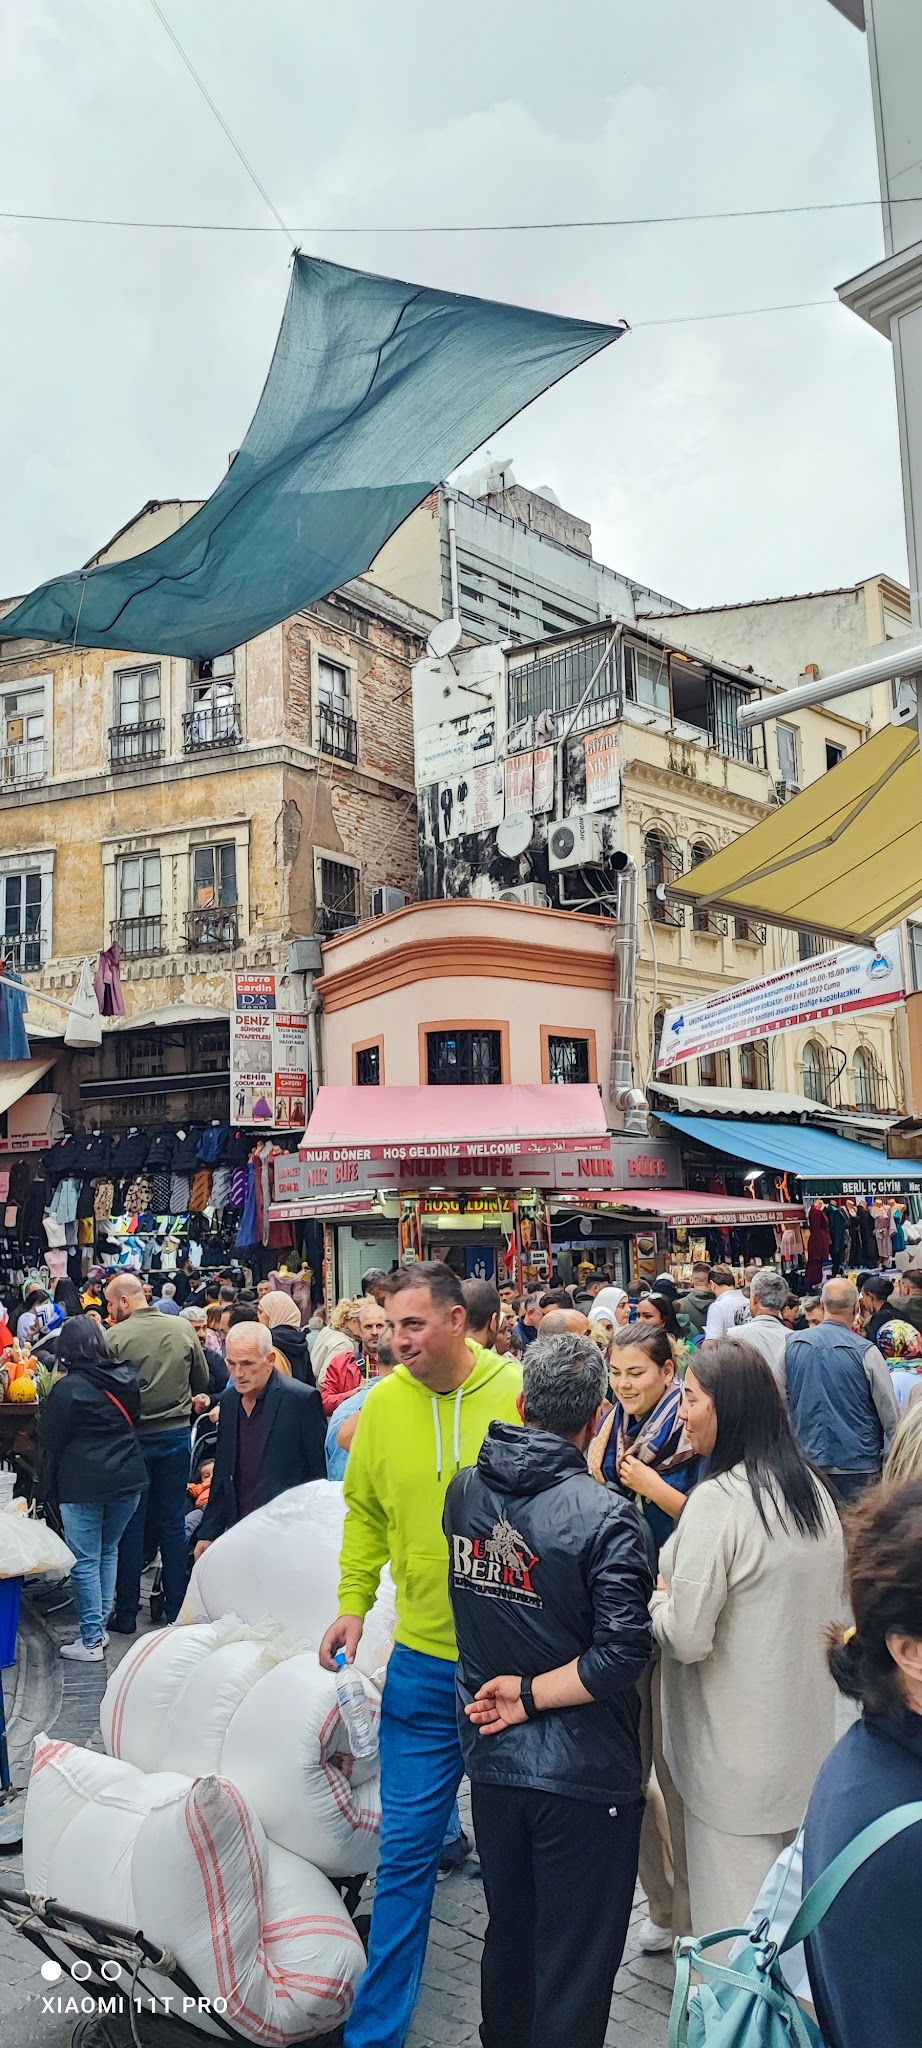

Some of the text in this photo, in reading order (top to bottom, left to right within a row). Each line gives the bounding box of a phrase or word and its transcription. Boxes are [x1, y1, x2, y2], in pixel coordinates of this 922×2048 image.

[237, 975, 271, 984] pierre
[237, 984, 272, 992] cardin
[236, 1014, 270, 1026] DENİZ
[239, 1072, 267, 1080] NEHİR
[306, 1142, 521, 1162] NUR DÖNER HOŞ GELDİNİZ WELCOME
[308, 1167, 328, 1187] NUR
[335, 1160, 359, 1183] BÜFE
[399, 1159, 447, 1178] NUR
[578, 1158, 614, 1177] NUR
[628, 1153, 667, 1177] BÜFE
[842, 1180, 867, 1193] BERİL
[868, 1180, 877, 1194] İÇ
[878, 1179, 901, 1193] GİYİM
